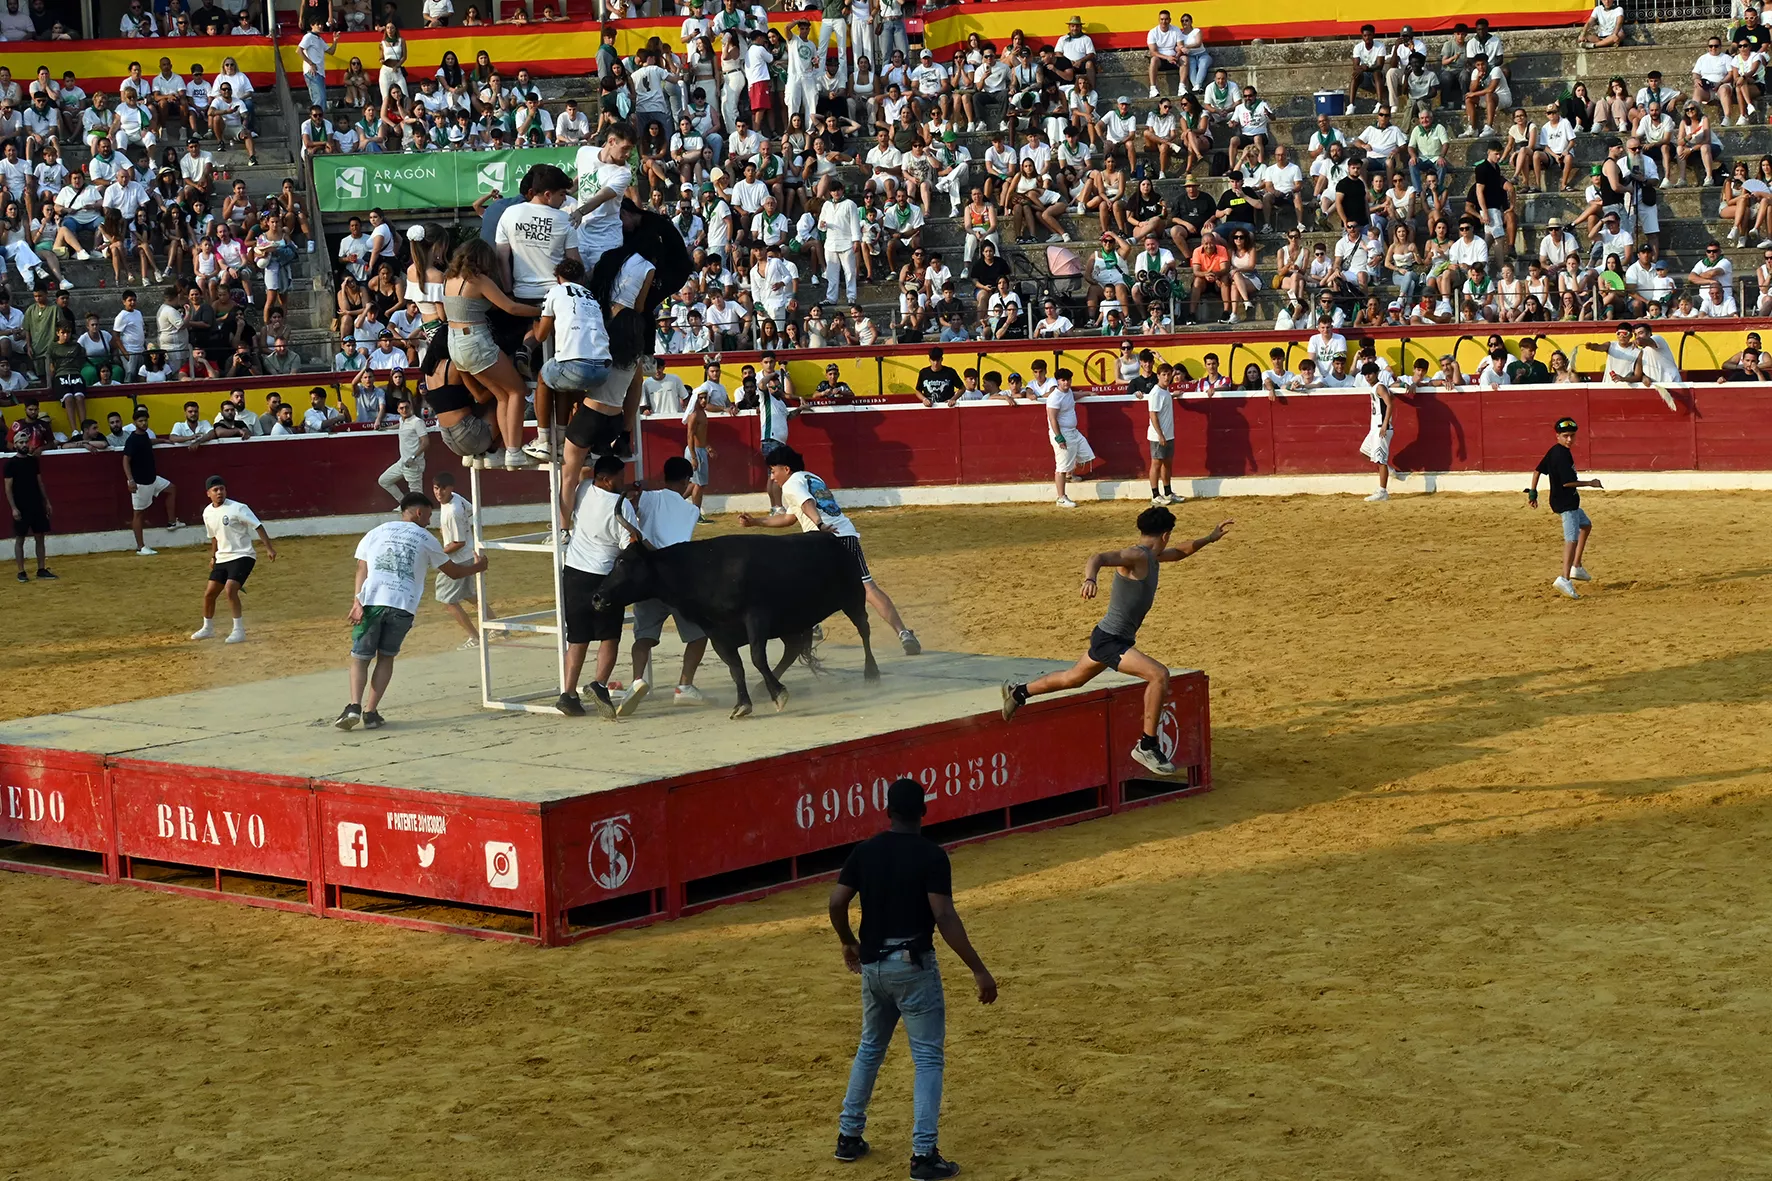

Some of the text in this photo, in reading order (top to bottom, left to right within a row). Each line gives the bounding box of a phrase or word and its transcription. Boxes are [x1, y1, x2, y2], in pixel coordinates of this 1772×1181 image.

[374, 167, 436, 180] ARAGÓN
[374, 183, 393, 194] TV
[515, 223, 552, 234] NORTH
[532, 216, 553, 226] THE
[525, 232, 551, 242] FACE
[1095, 358, 1106, 382] 1
[795, 752, 1008, 830] 69602858
[0, 785, 65, 823] EDO
[157, 803, 265, 849] BRAVO
[394, 812, 418, 832] PATENTE
